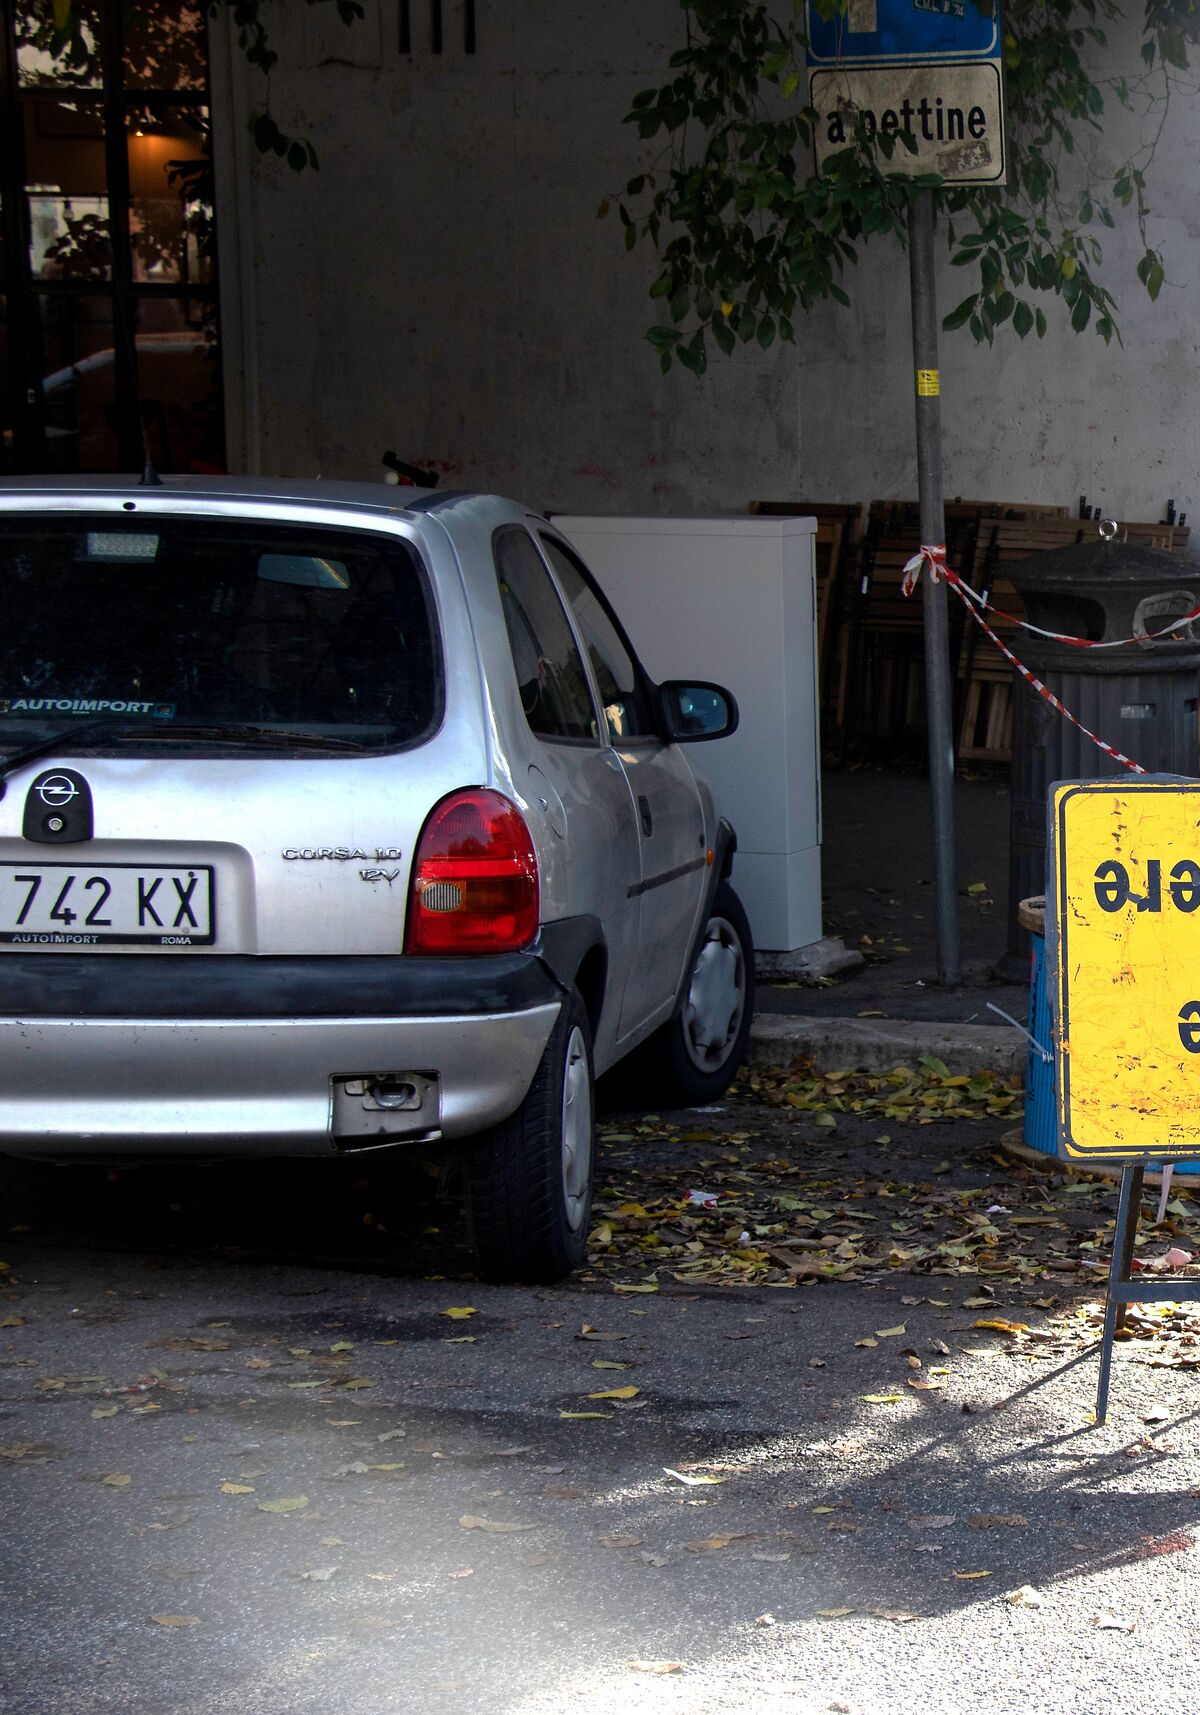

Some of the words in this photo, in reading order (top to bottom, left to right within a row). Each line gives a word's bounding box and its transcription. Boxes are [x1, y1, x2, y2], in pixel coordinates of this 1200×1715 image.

[826, 111, 846, 143] a
[12, 699, 153, 713] AUTOIMPORT
[281, 847, 368, 860] CORSA
[359, 868, 400, 882] 12V
[14, 875, 112, 926] 742
[137, 877, 199, 928] KX
[12, 934, 99, 944] AUTOIMPORT
[161, 936, 192, 945] ROMA
